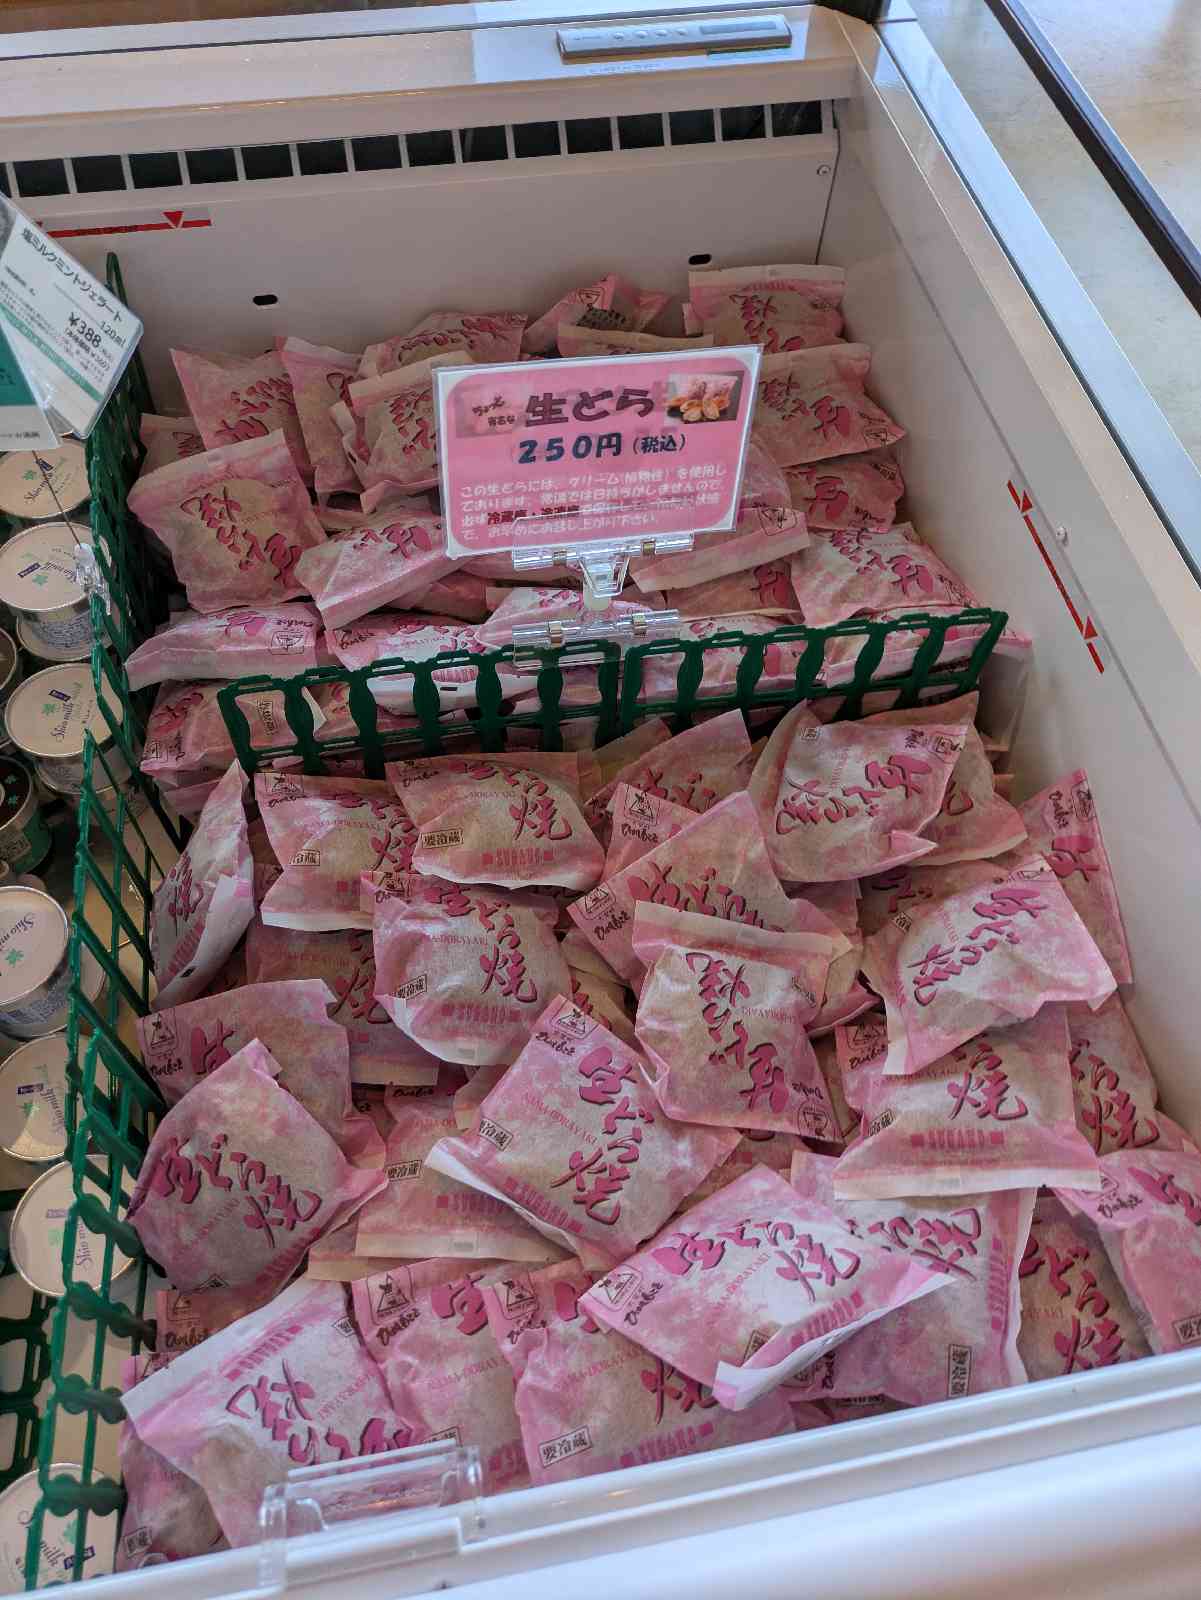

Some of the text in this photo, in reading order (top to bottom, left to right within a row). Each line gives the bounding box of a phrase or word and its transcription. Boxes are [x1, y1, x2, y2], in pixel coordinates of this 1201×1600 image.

[525, 387, 655, 427] 生どら
[518, 432, 686, 464] 250円 （税込）
